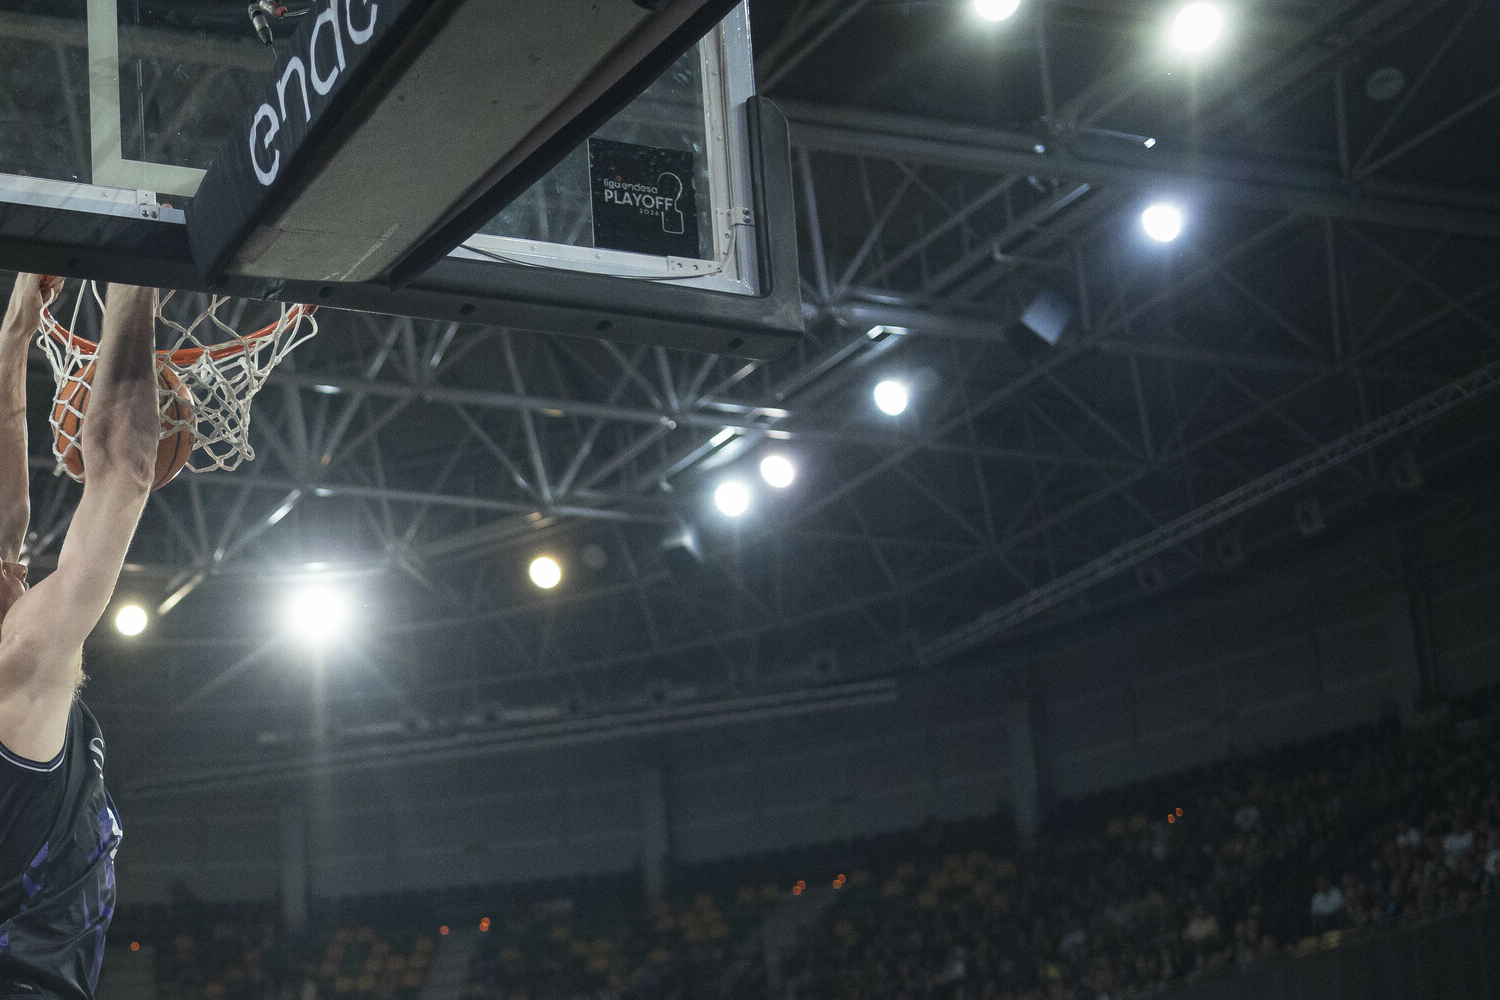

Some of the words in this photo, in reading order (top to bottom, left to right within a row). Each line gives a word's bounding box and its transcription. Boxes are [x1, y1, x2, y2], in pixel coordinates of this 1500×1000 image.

[603, 178, 621, 190] liga
[621, 182, 658, 194] endesa
[604, 189, 674, 211] PLAYOFF
